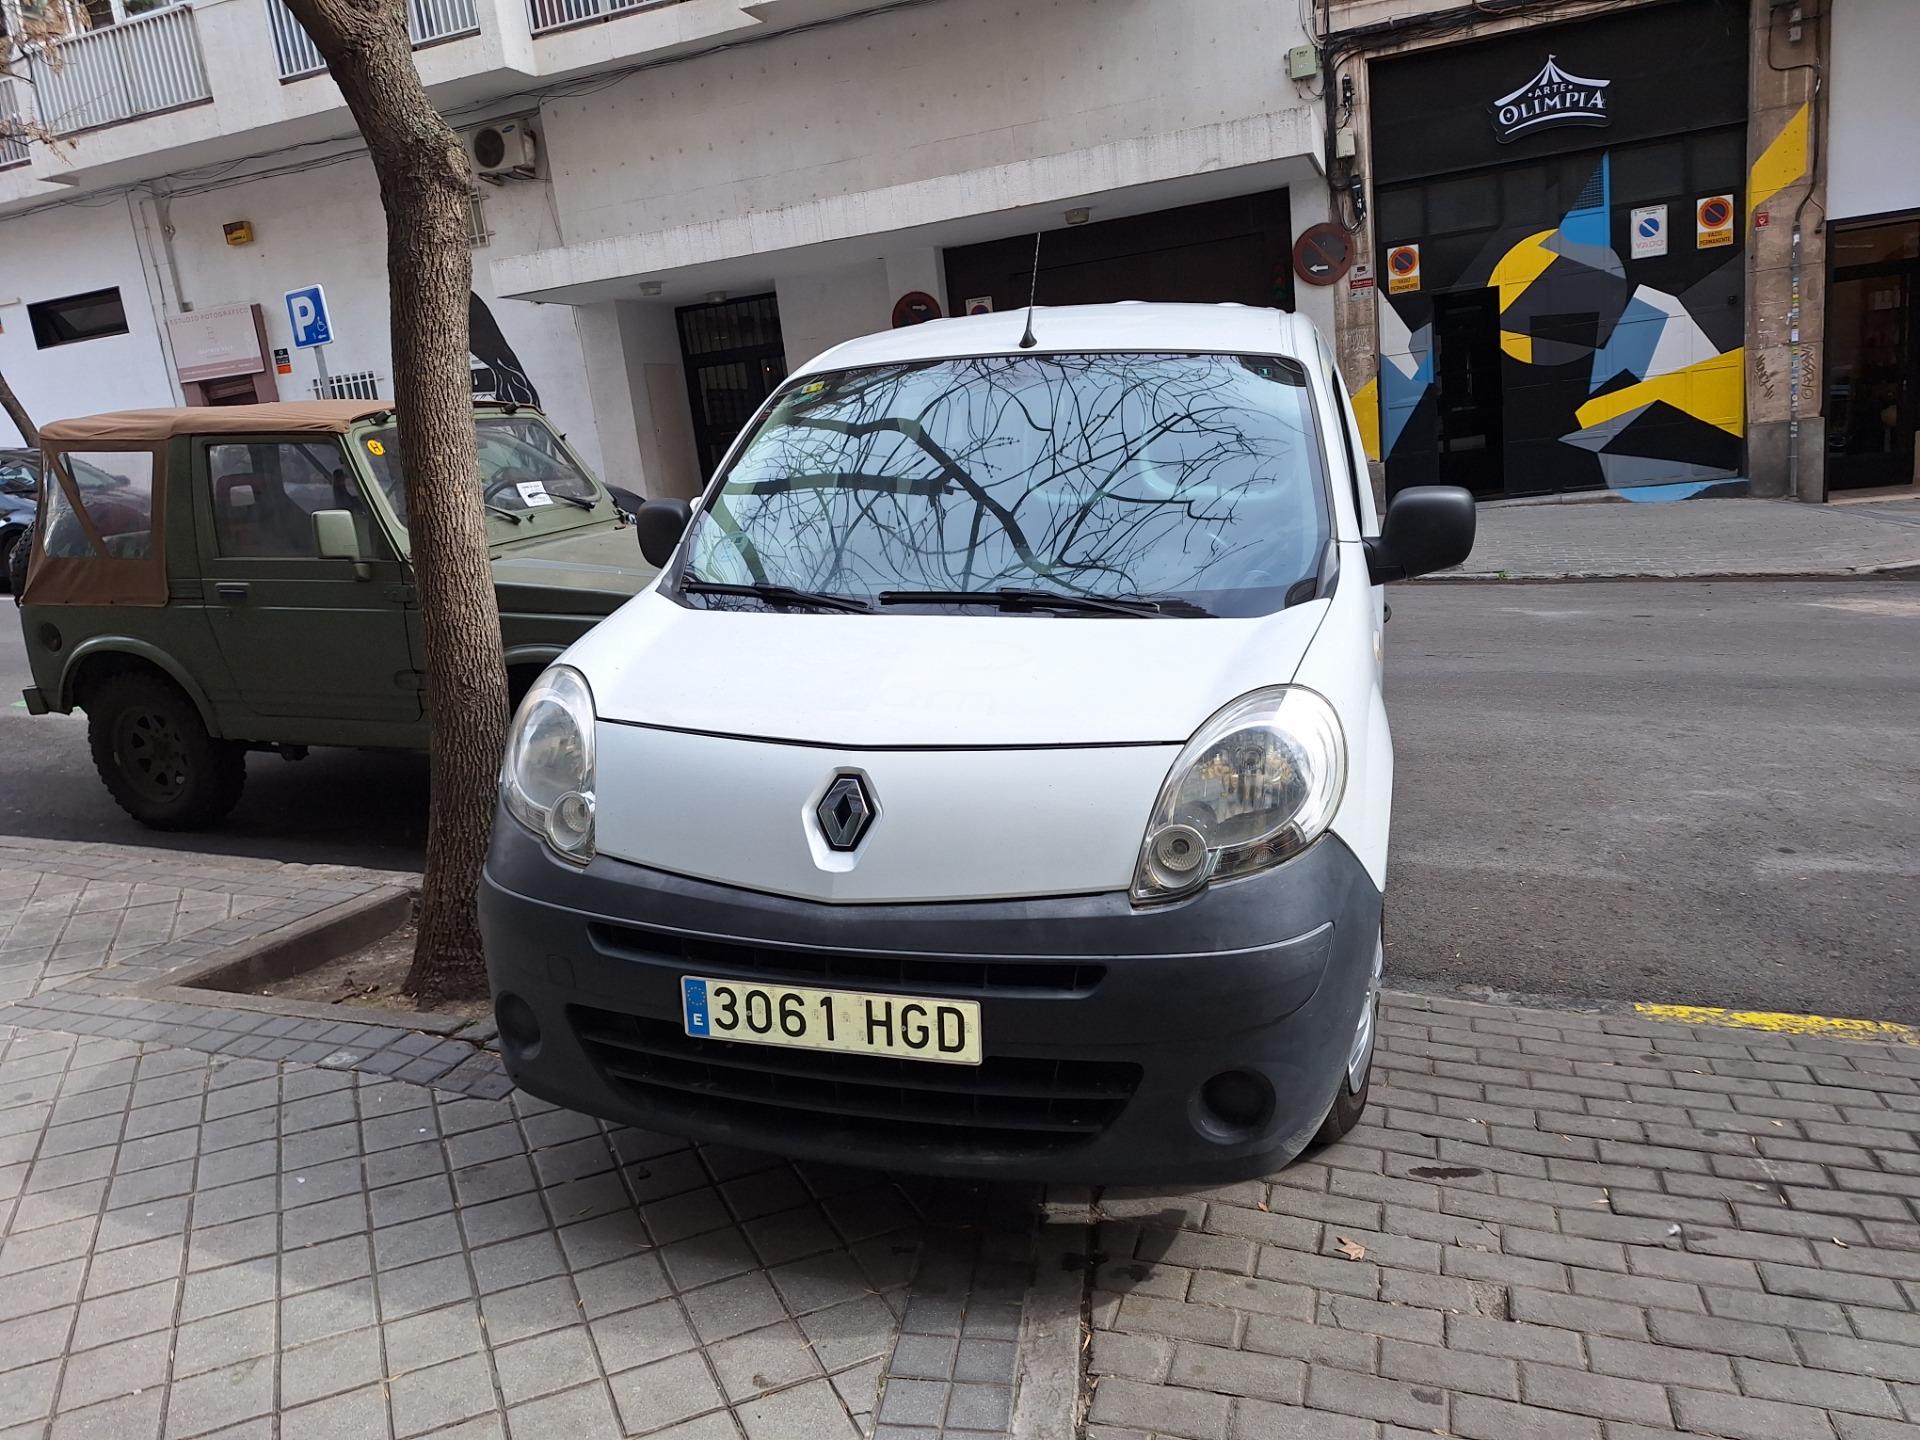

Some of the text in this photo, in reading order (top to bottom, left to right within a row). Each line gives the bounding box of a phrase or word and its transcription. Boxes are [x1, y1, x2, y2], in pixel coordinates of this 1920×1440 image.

[1534, 84, 1566, 97] ARTE
[1499, 89, 1607, 125] OLIMPIA
[1635, 240, 1665, 250] VADO
[291, 296, 316, 342] P
[693, 1013, 704, 1026] E
[713, 986, 966, 1053] 3061 HGD
